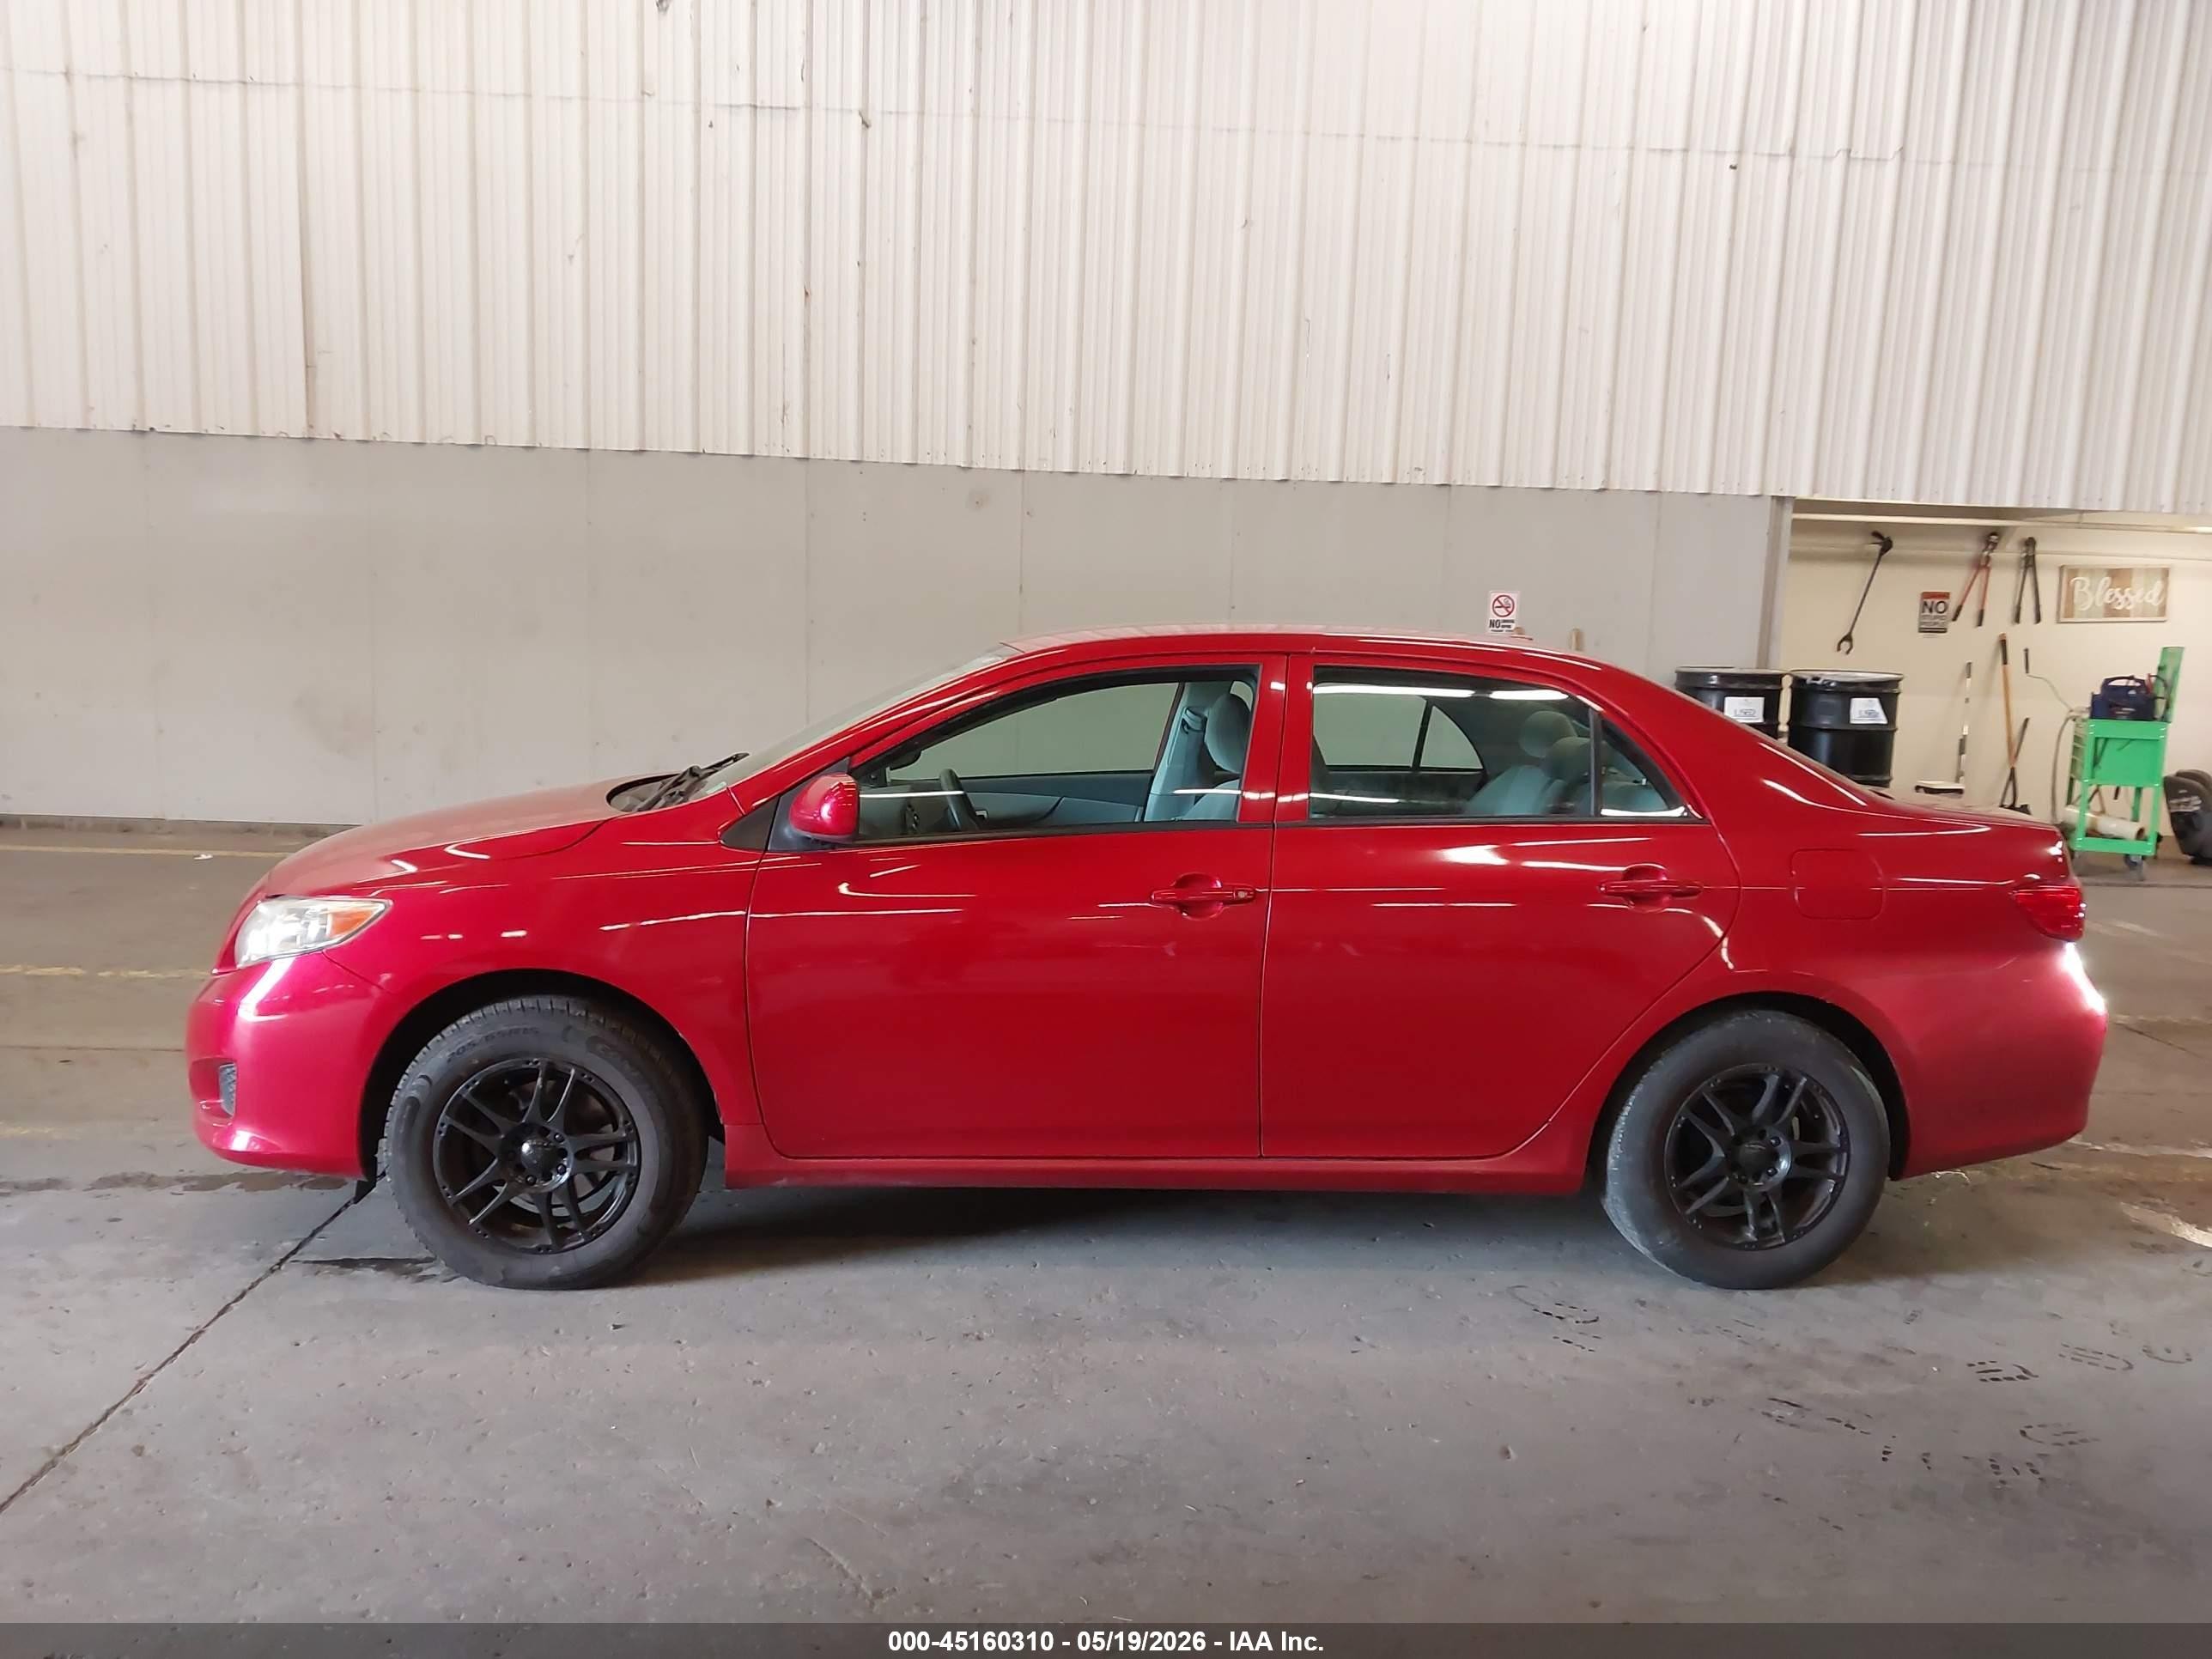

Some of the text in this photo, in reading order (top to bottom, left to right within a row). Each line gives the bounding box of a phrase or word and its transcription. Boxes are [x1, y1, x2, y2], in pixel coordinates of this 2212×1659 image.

[2069, 576, 2163, 611] Blessed
[1922, 600, 1948, 614] NO
[1489, 619, 1501, 629] NO
